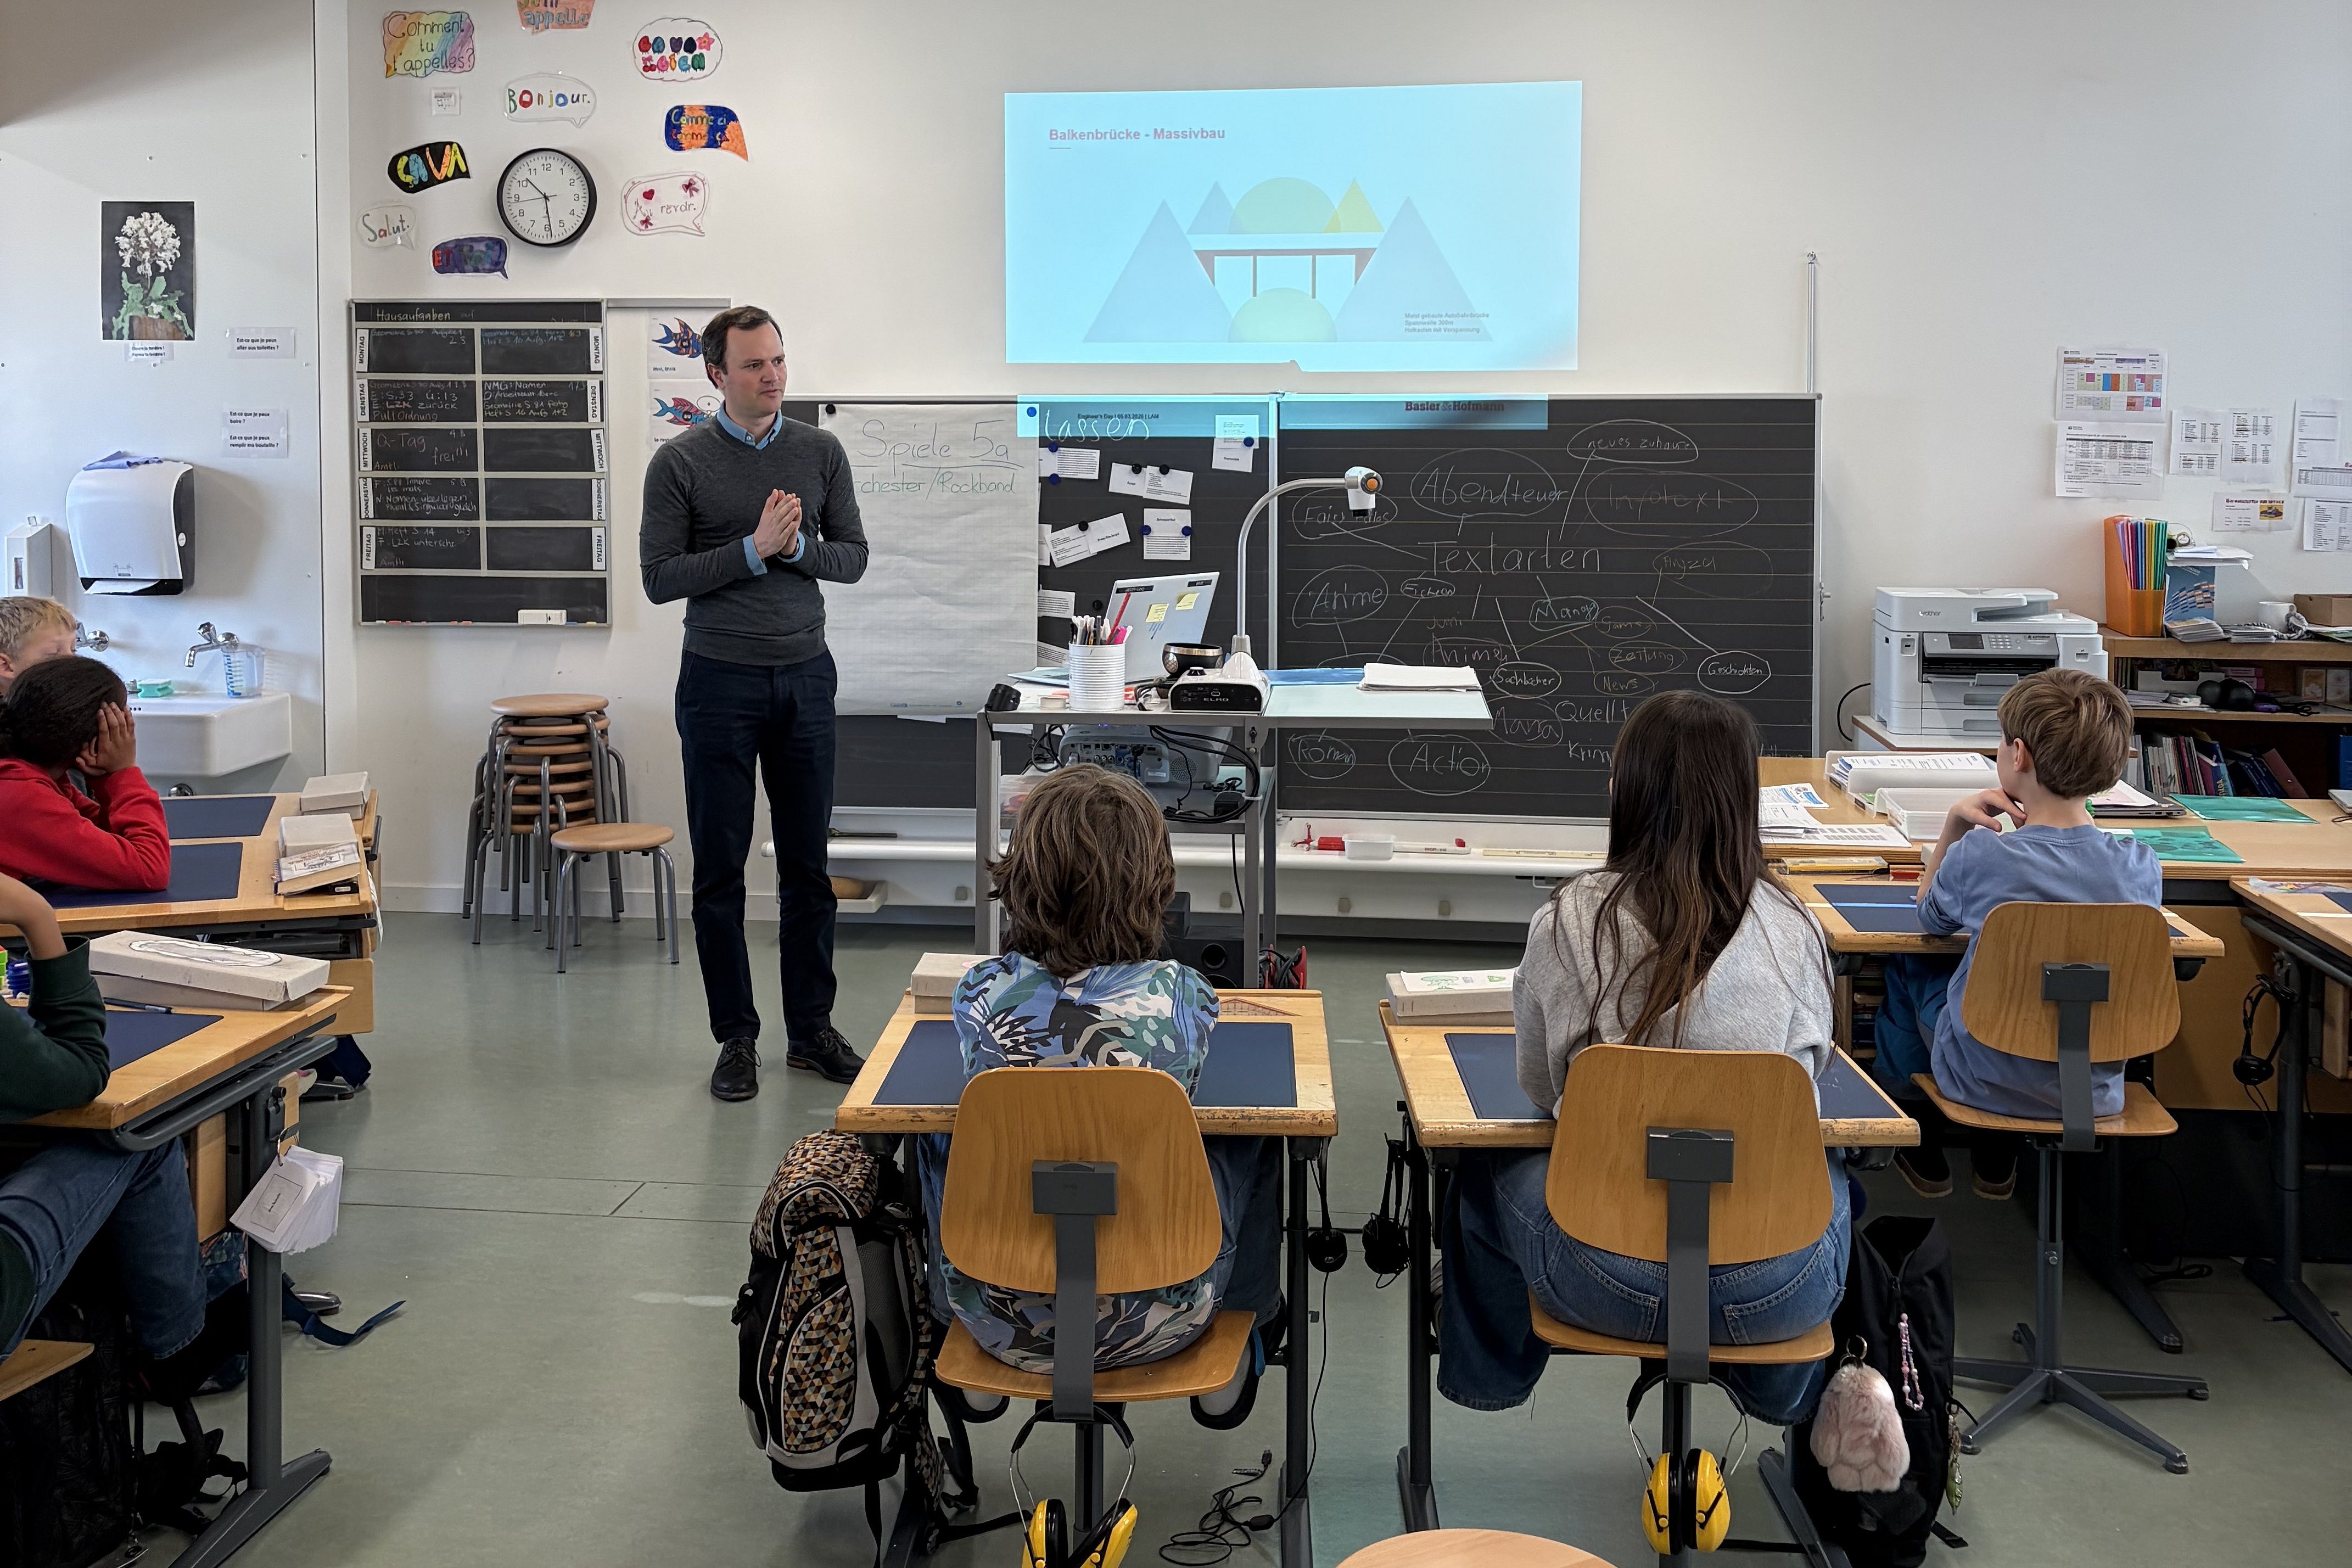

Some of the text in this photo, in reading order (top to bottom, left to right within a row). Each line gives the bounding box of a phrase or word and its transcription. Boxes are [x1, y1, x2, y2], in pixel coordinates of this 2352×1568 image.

[387, 13, 464, 38] Comment
[524, 8, 589, 29] appelle
[420, 38, 434, 52] tu
[671, 109, 726, 125] Comme ci
[1049, 128, 1140, 141] Balkenbrücke
[1153, 127, 1225, 139] Massivbau
[517, 180, 528, 188] 10
[434, 249, 452, 267] ET
[377, 307, 451, 322] Hausaufgaben
[1405, 401, 1440, 411] Basler
[1453, 401, 1504, 411] Hofmann
[1045, 410, 1150, 443] lassen
[377, 432, 426, 452] Q-Tag
[595, 432, 604, 469] MITTWOCH
[857, 419, 1009, 477] Spiele 5a
[1419, 466, 1568, 506] Abendteuer
[1610, 483, 1733, 521] Infotext
[1418, 529, 1599, 576] Textarten
[1311, 583, 1382, 618] Anime
[1536, 602, 1597, 623] Manga
[1708, 662, 1763, 676] Geschichten
[1603, 677, 1638, 693] News
